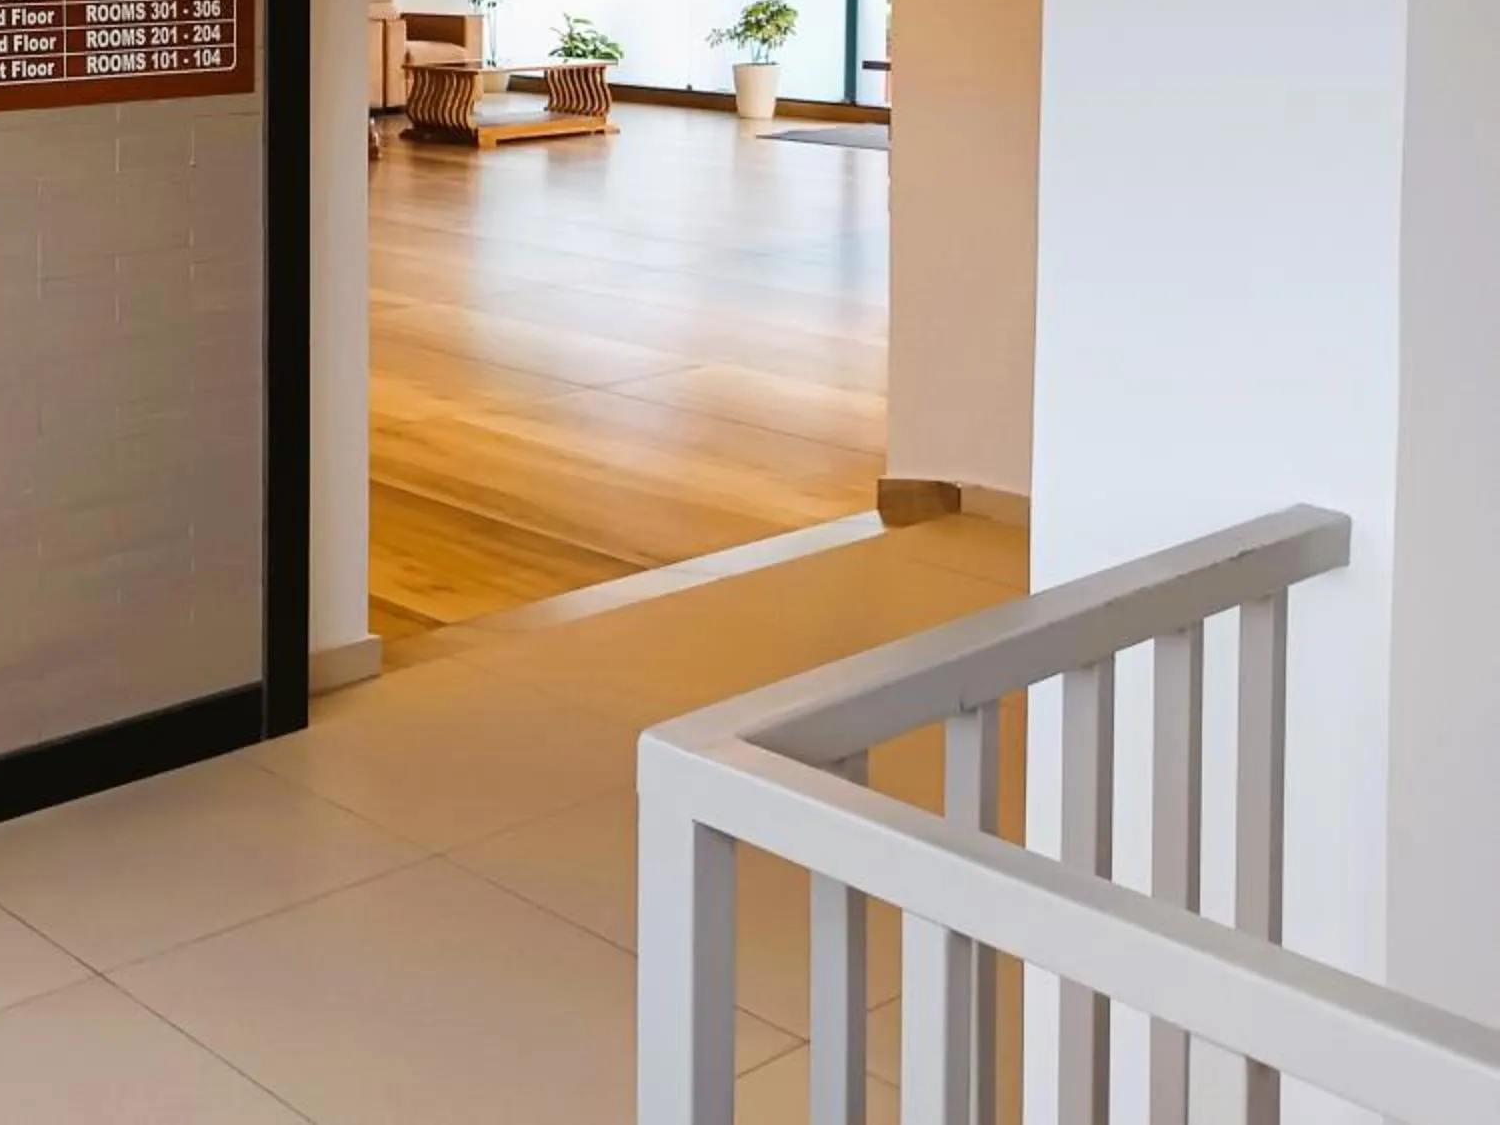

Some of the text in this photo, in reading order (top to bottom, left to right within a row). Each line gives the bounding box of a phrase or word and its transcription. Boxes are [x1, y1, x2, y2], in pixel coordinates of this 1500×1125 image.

[11, 8, 55, 26] Floor
[86, 2, 147, 23] ROOMS
[150, 1, 178, 20] 301
[193, 0, 221, 18] 306
[13, 34, 57, 52] Floor
[86, 28, 146, 48] ROOMS
[151, 26, 178, 45] 201
[193, 24, 221, 43] 204
[11, 60, 55, 78] Floor
[86, 53, 146, 74] ROOMS
[151, 51, 178, 69] 101
[193, 49, 221, 67] 104
